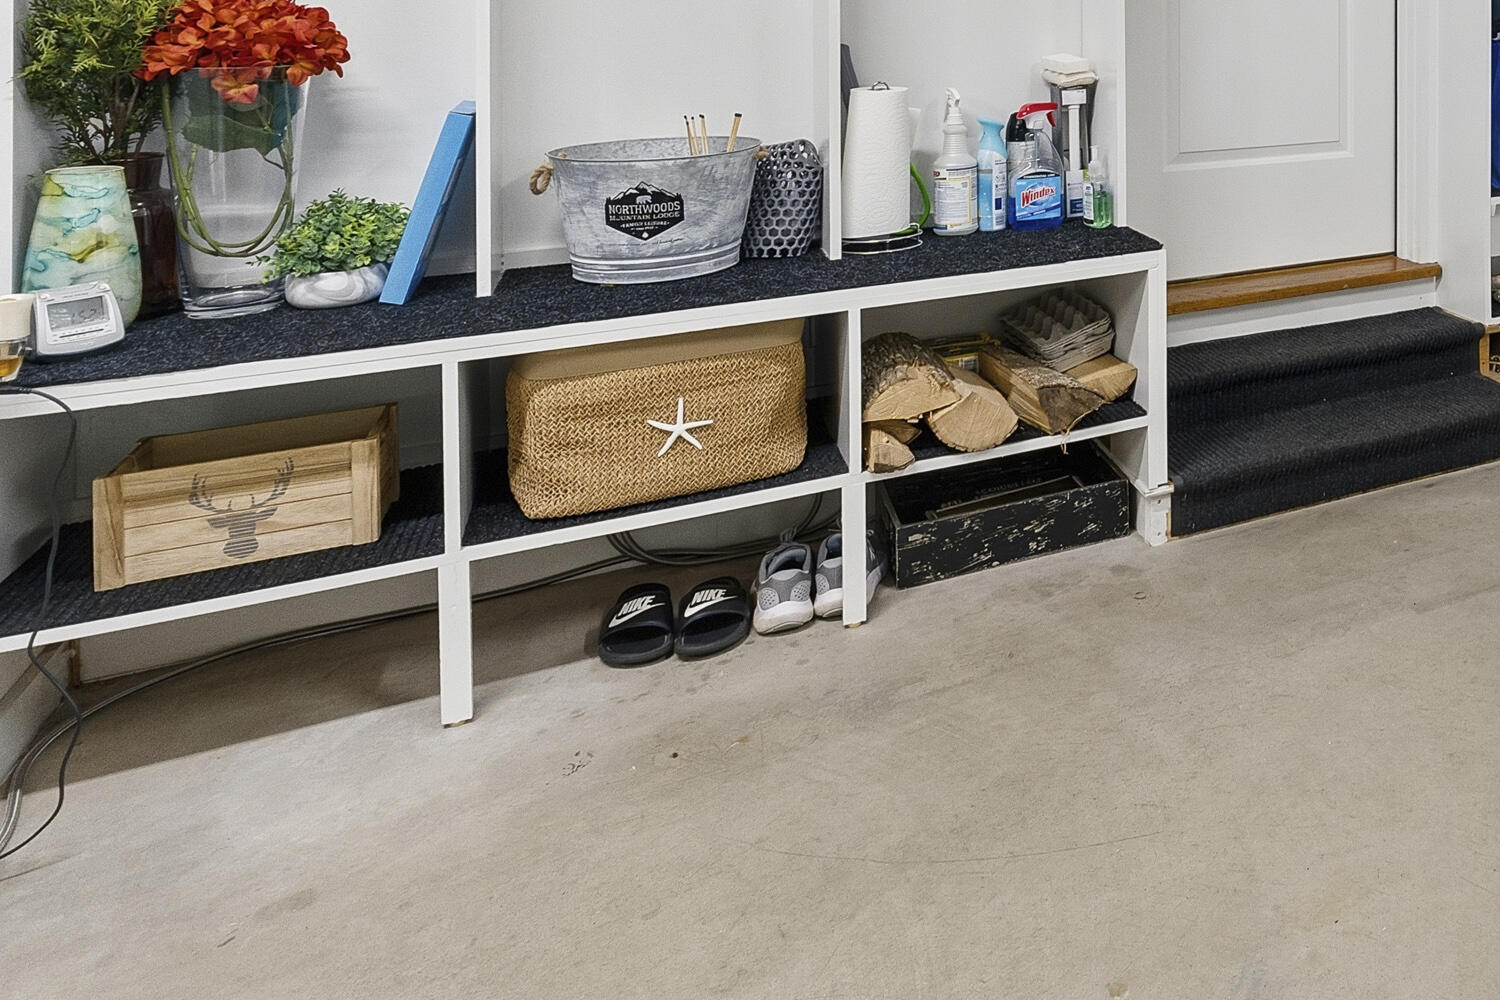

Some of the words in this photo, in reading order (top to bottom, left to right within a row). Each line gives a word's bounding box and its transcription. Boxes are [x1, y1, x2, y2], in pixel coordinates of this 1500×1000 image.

[1021, 186, 1056, 208] Windex
[608, 201, 681, 214] NORTHWOODS
[652, 211, 680, 220] LODGE
[617, 595, 656, 617] NIKE
[690, 588, 727, 606] NIKE
